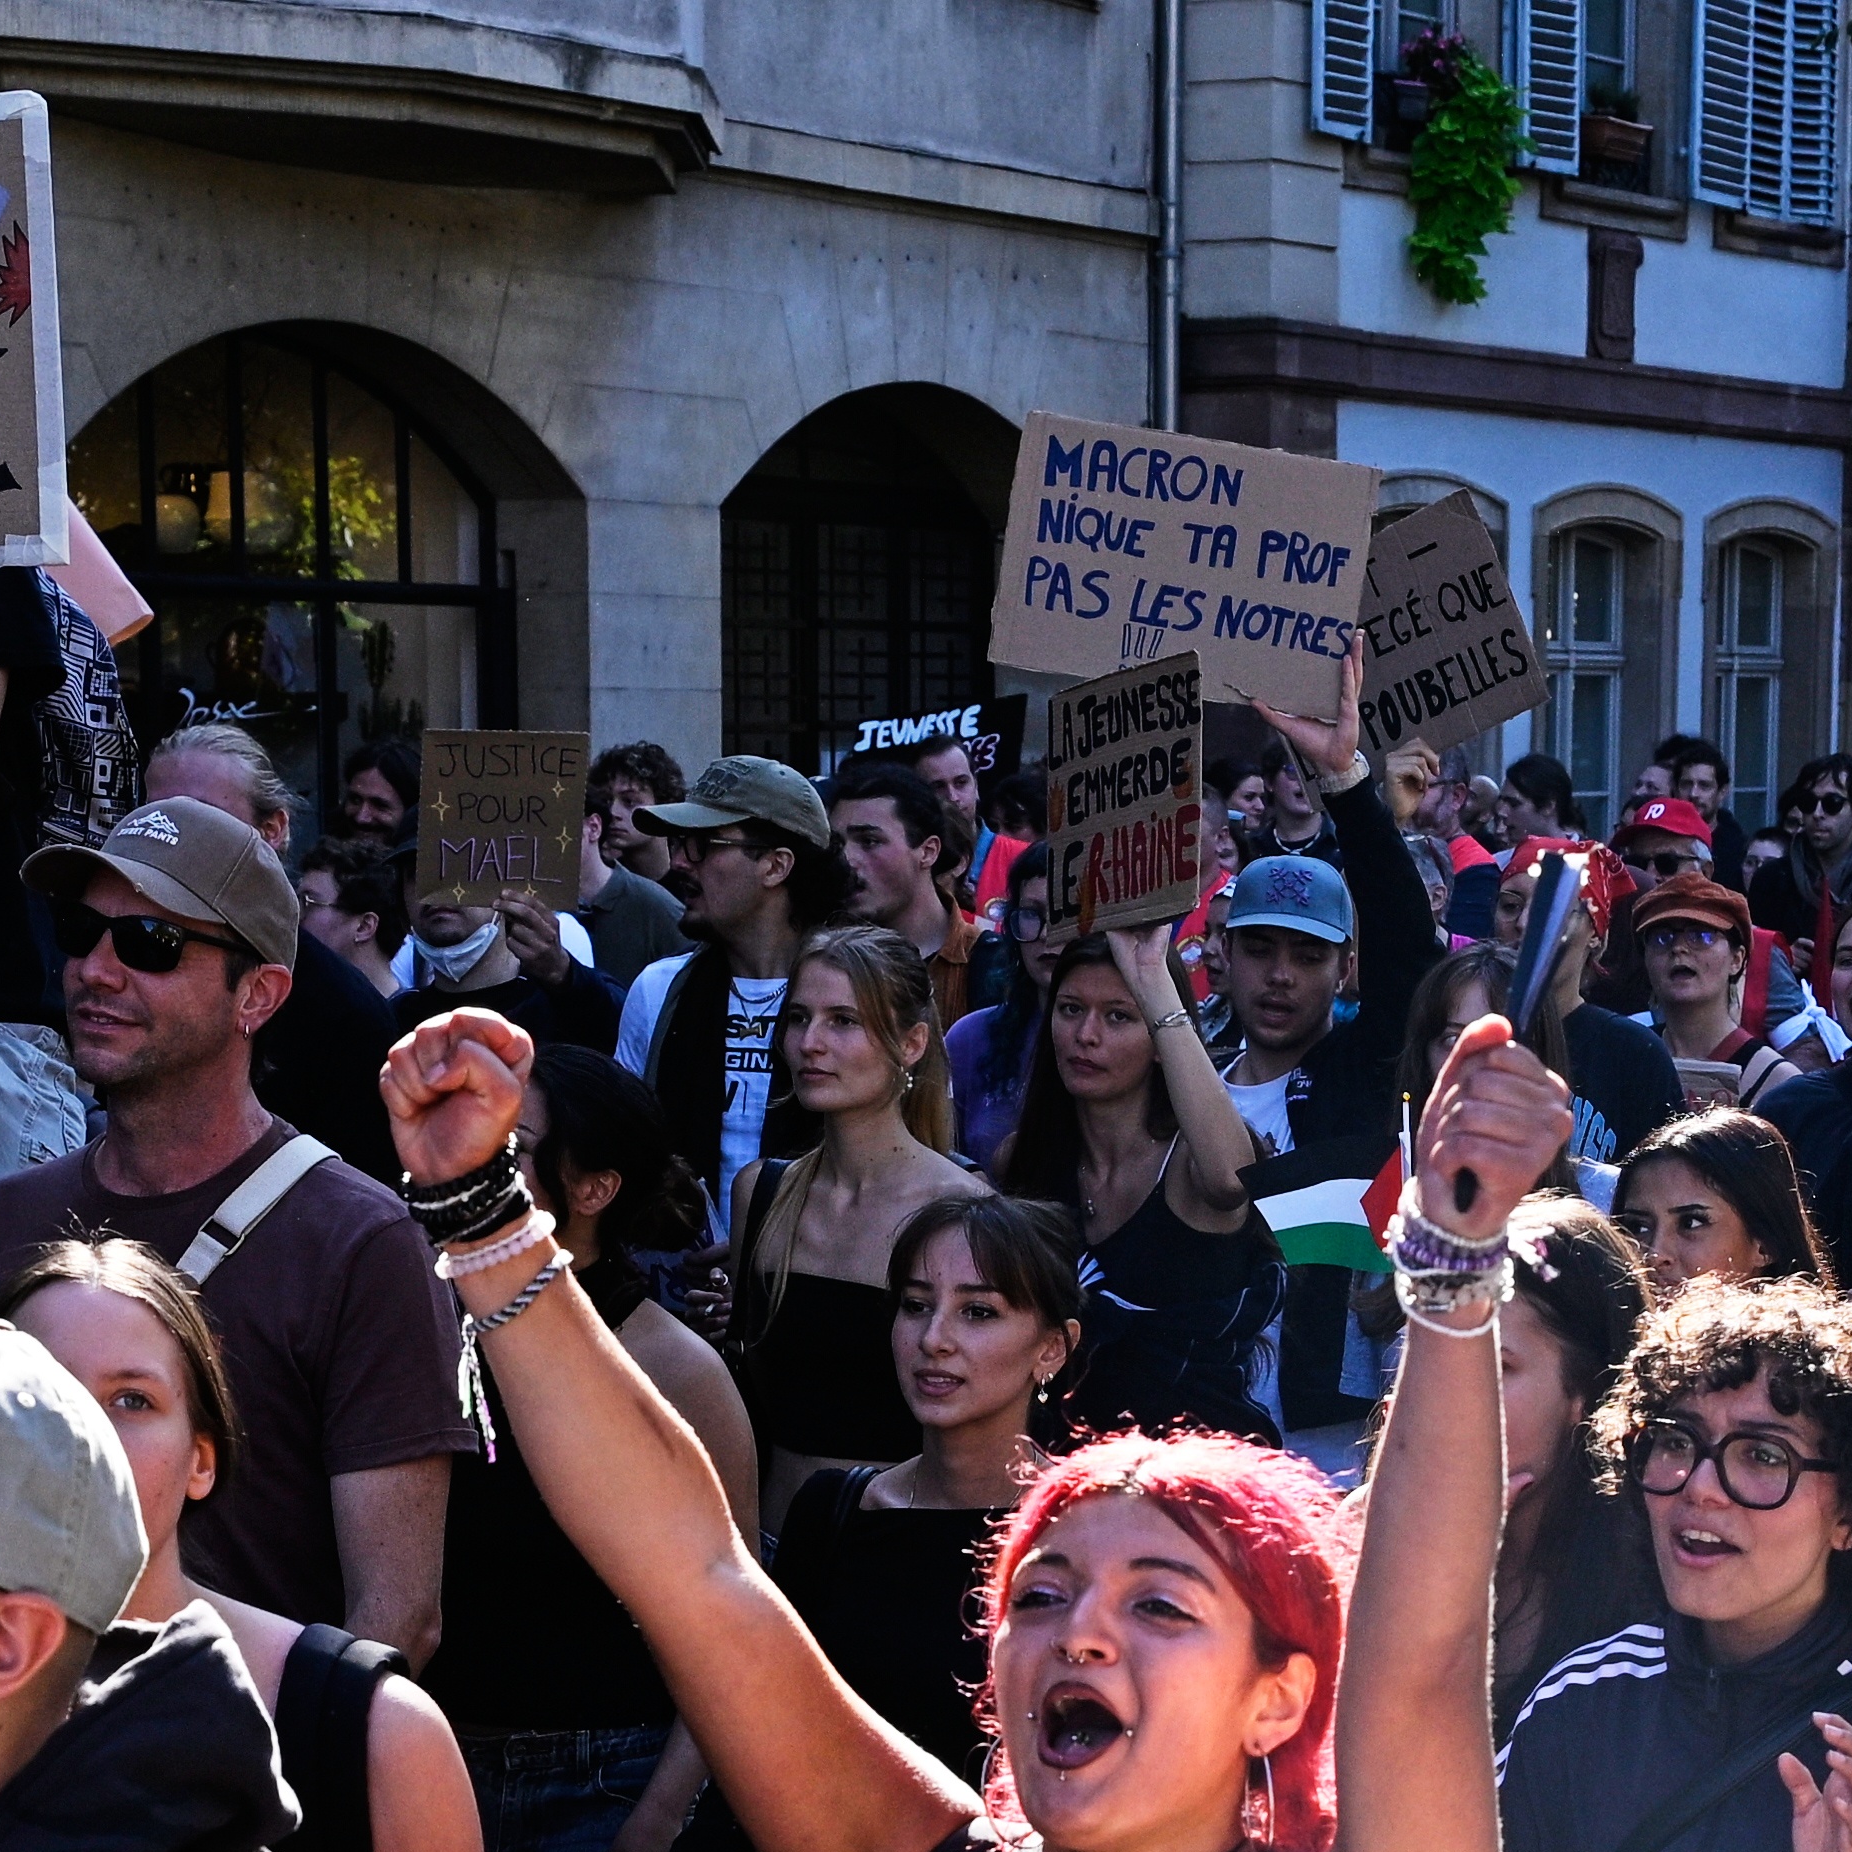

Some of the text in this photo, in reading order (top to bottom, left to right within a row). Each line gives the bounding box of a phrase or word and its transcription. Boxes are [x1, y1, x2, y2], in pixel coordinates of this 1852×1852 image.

[1044, 434, 1244, 507] MACRON
[1037, 493, 1351, 587] NIQUE TA PROF
[1025, 555, 1354, 660] PAS LES NOTRES
[1438, 562, 1508, 622] QUE
[1049, 699, 1075, 771] LA
[1077, 669, 1202, 759] JEUNESSE
[1358, 628, 1529, 750] POUBELLES
[435, 739, 581, 779] JUSTICE
[853, 703, 982, 753] JEUNESSE
[458, 792, 548, 827] POUR
[1067, 737, 1193, 827] EMMERDE
[144, 828, 180, 846] PANTS
[439, 829, 563, 883] MAËL
[1049, 803, 1202, 925] LE R-HAINE
